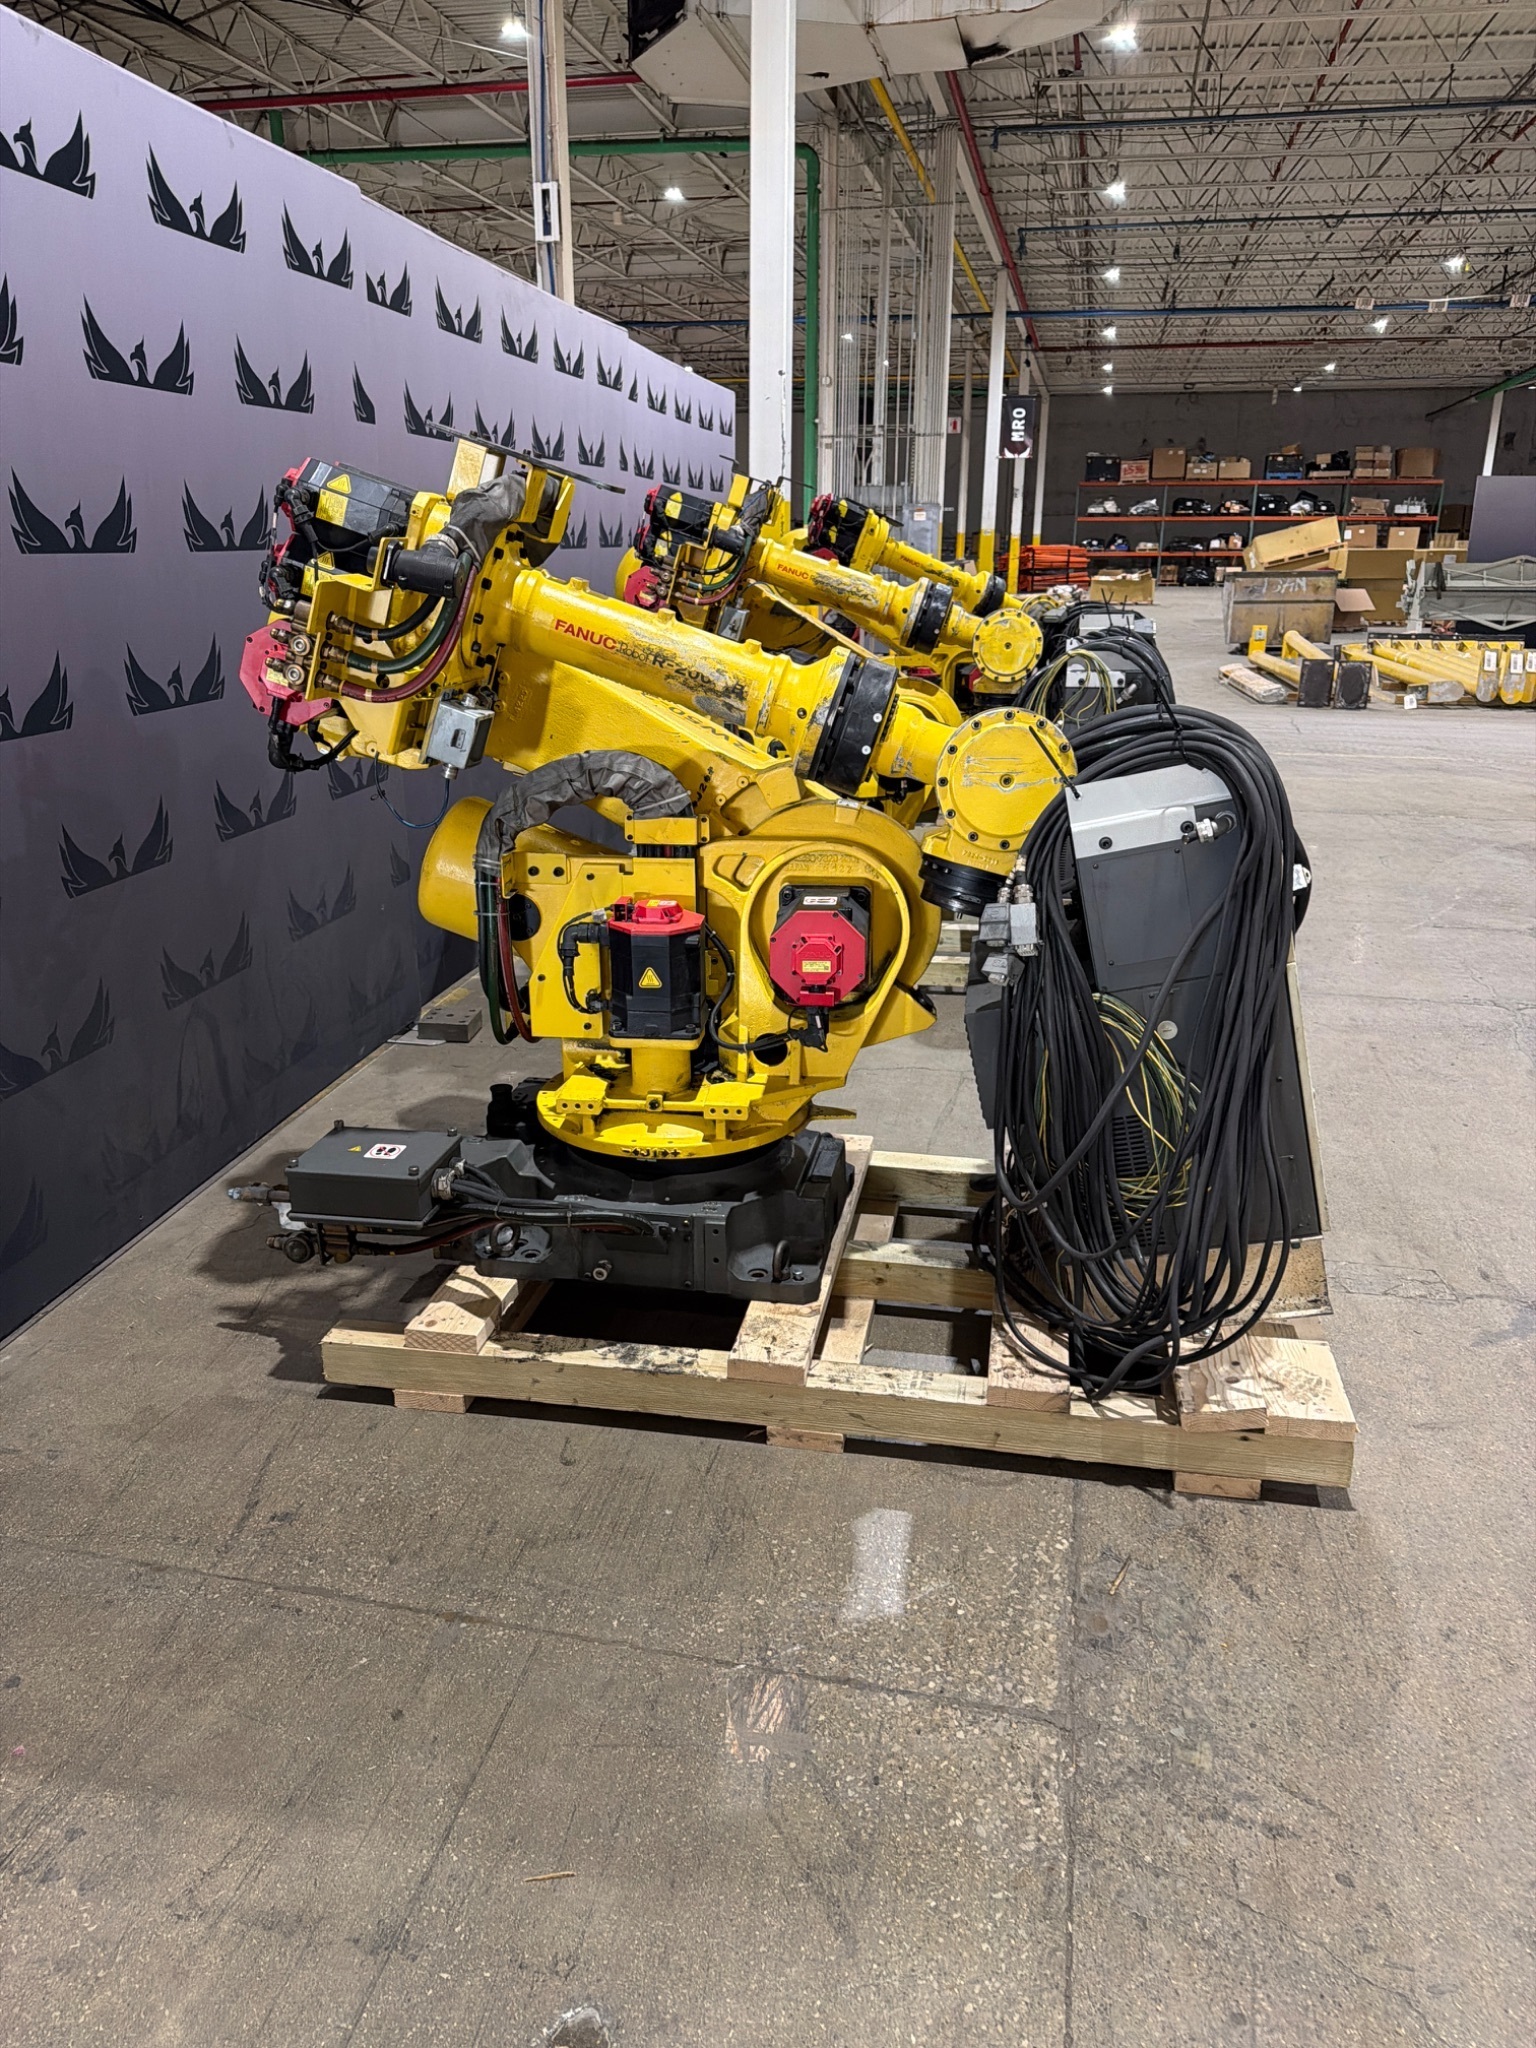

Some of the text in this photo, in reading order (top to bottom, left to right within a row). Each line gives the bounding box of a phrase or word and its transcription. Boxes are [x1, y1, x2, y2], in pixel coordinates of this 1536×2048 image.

[1011, 407, 1026, 442] MRO
[777, 563, 809, 580] FANUC
[554, 618, 617, 651] FANUC
